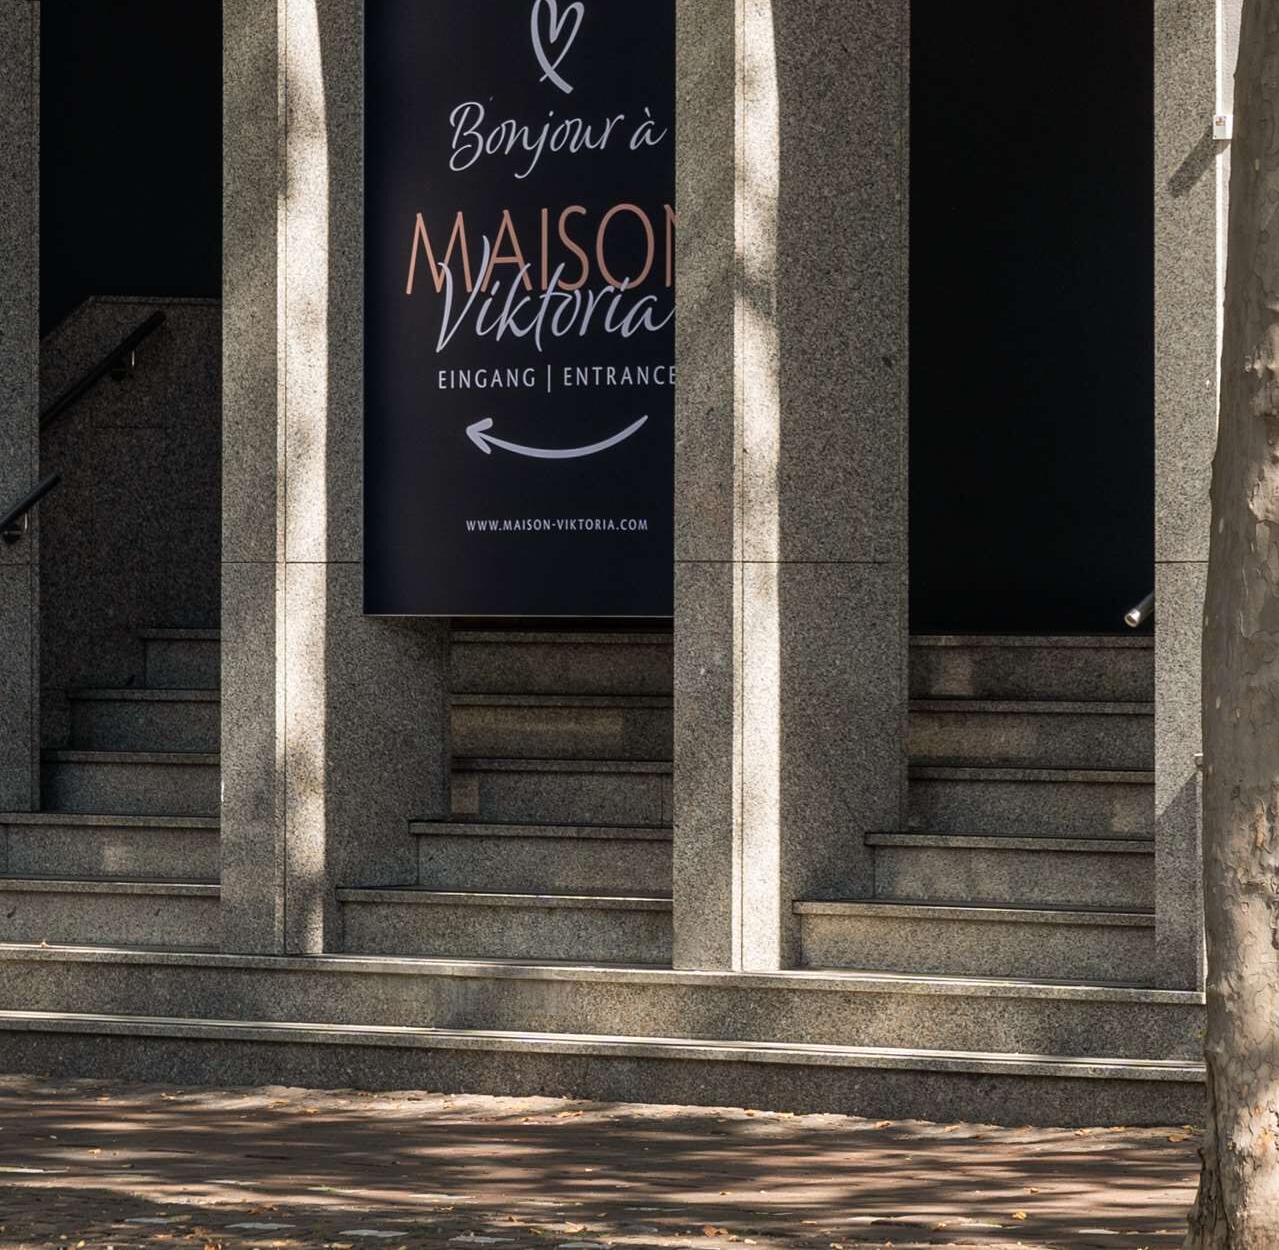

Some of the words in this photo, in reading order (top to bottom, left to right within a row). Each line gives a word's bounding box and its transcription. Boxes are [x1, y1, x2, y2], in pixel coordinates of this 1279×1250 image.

[449, 101, 624, 179] Bonjour
[629, 107, 667, 150] à
[406, 203, 676, 294] MAISO
[435, 235, 677, 353] Viktoria
[438, 368, 536, 389] EINGANG
[563, 365, 676, 387] ENTRANCE
[466, 518, 648, 531] WWW.MAISON-VIKTORIA.COM
